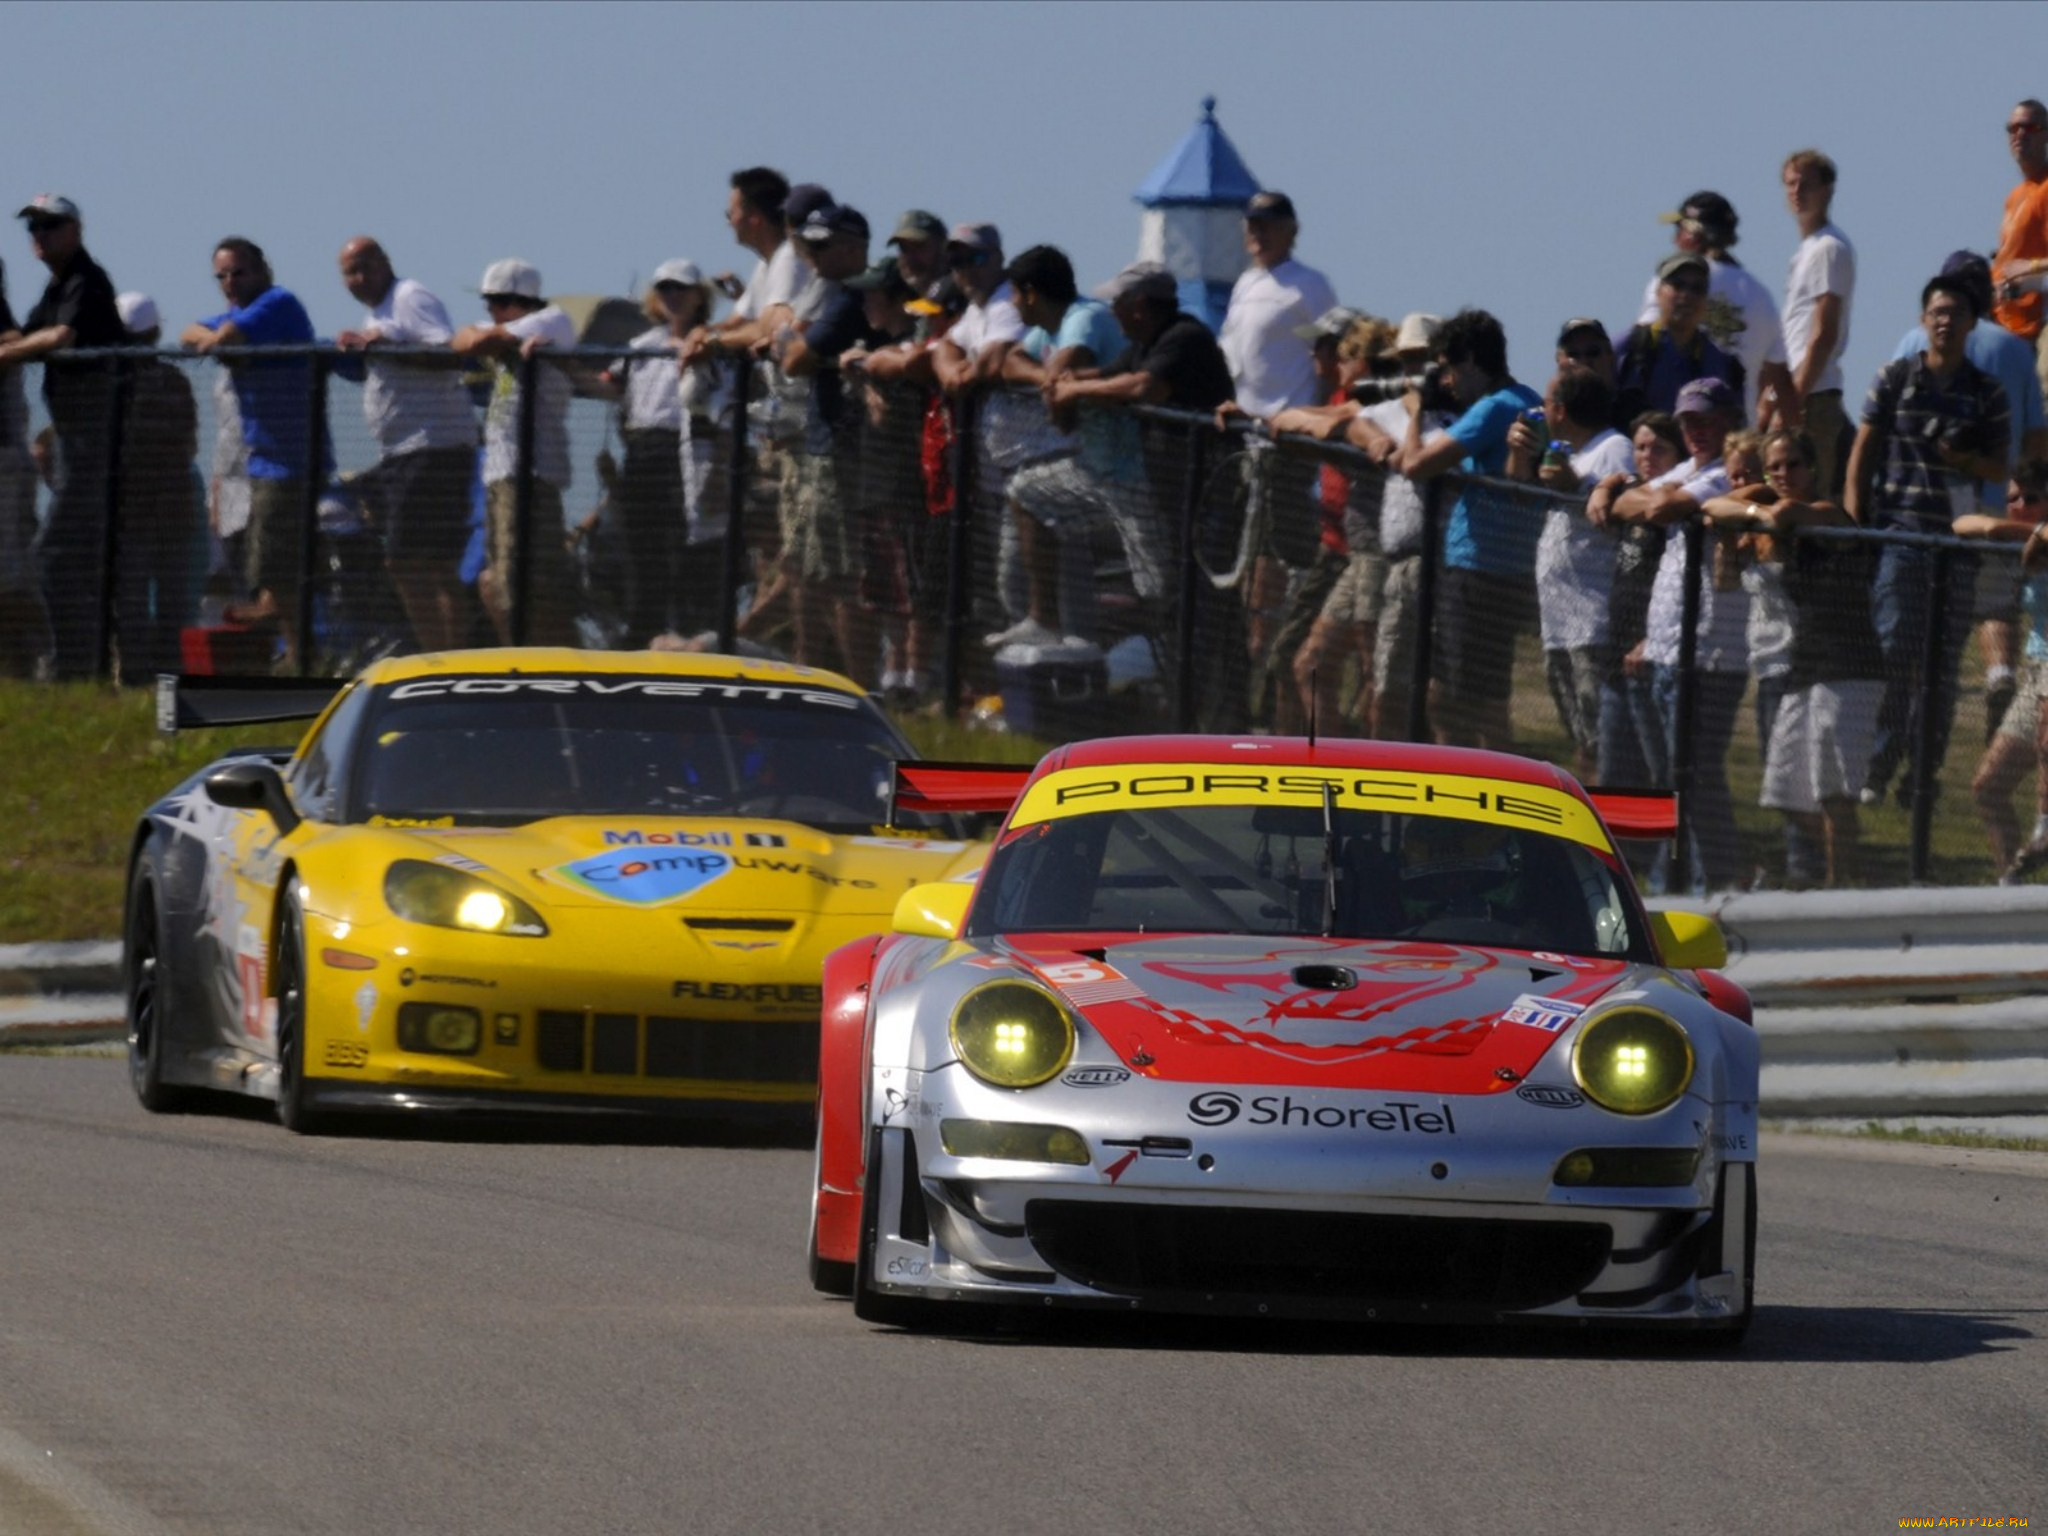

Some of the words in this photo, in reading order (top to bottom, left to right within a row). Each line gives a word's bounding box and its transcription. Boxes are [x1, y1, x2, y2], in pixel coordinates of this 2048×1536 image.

[389, 678, 858, 709] CORVETTE
[1056, 775, 1563, 826] PORSCHE
[603, 830, 731, 846] Mobil
[580, 850, 877, 889] Compuware
[1039, 963, 1106, 984] 5
[672, 980, 823, 1003] FLEXFUE
[1066, 1071, 1132, 1083] HELLA
[1521, 1087, 1585, 1104] HELLA
[1248, 1096, 1456, 1134] ShoreTel
